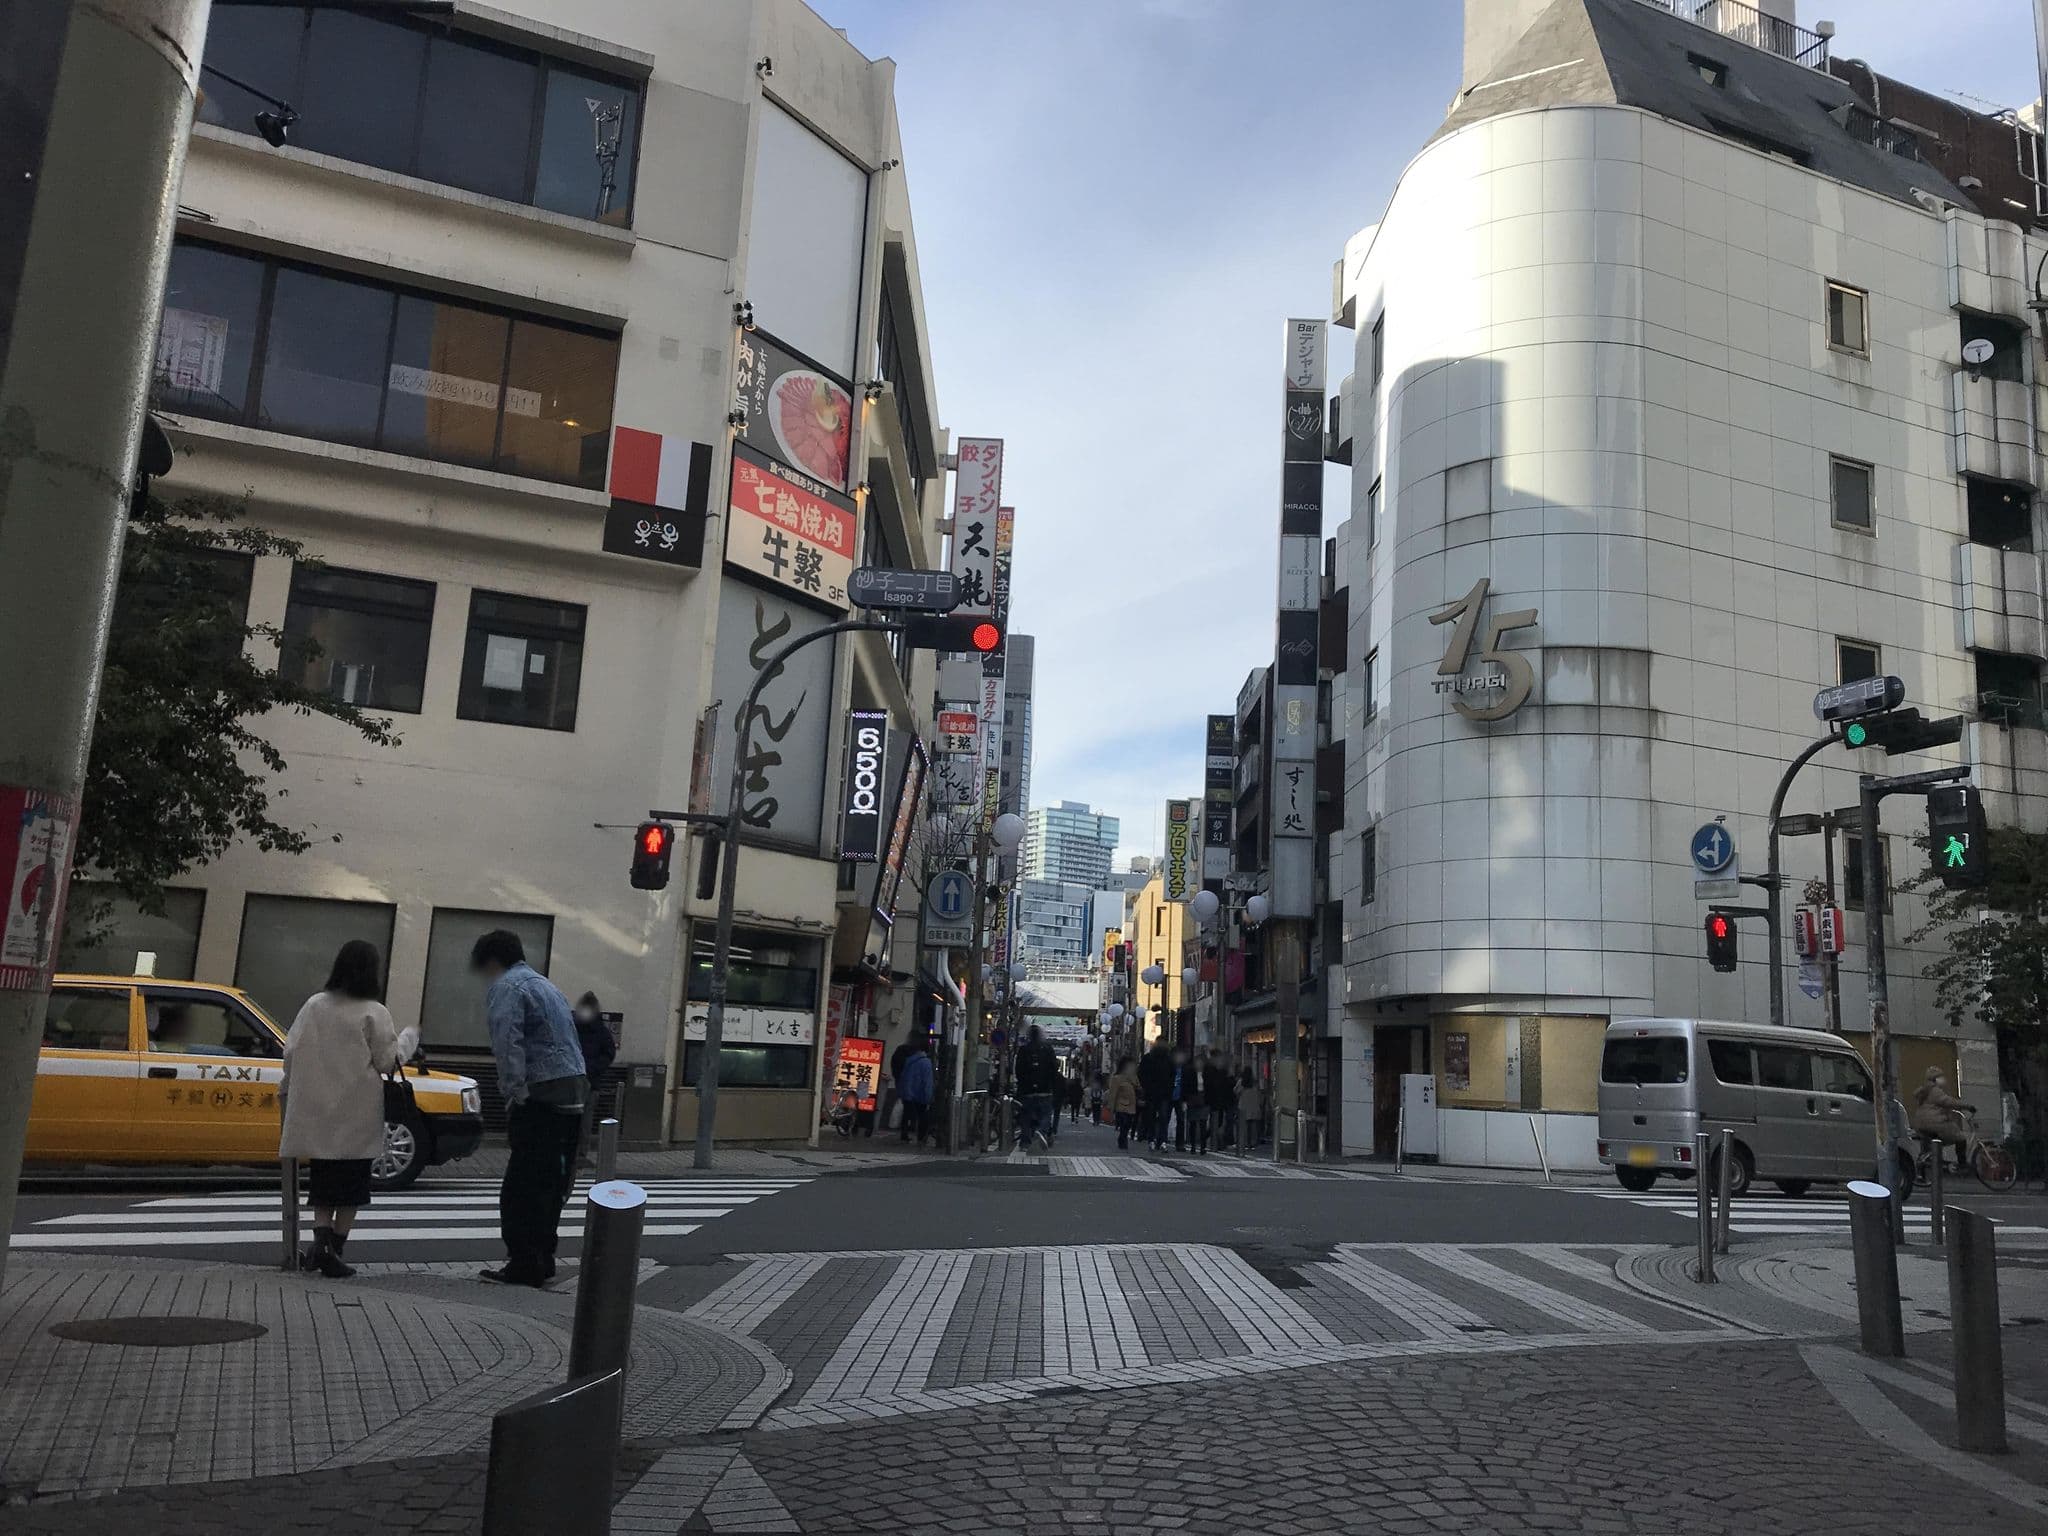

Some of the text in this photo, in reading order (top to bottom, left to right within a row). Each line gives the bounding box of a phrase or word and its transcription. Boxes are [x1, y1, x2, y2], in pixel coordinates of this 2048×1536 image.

[1297, 323, 1317, 332] Bar
[959, 444, 979, 514] 餃子
[753, 479, 844, 548] 七輪焼肉
[762, 525, 824, 593] 牛繁
[828, 585, 845, 602] 3F
[855, 570, 954, 593] 砂子二丁目
[884, 587, 925, 604] Isago 2
[1428, 577, 1539, 722] 15
[983, 679, 998, 721] カラオケ
[1818, 677, 1886, 710] 砂子二丁目
[849, 727, 882, 815] 6,500
[1168, 823, 1187, 898] アロマエステ
[766, 1019, 801, 1038] とん吉
[197, 1064, 262, 1082] TAXI
[840, 1060, 873, 1082] 牛繁
